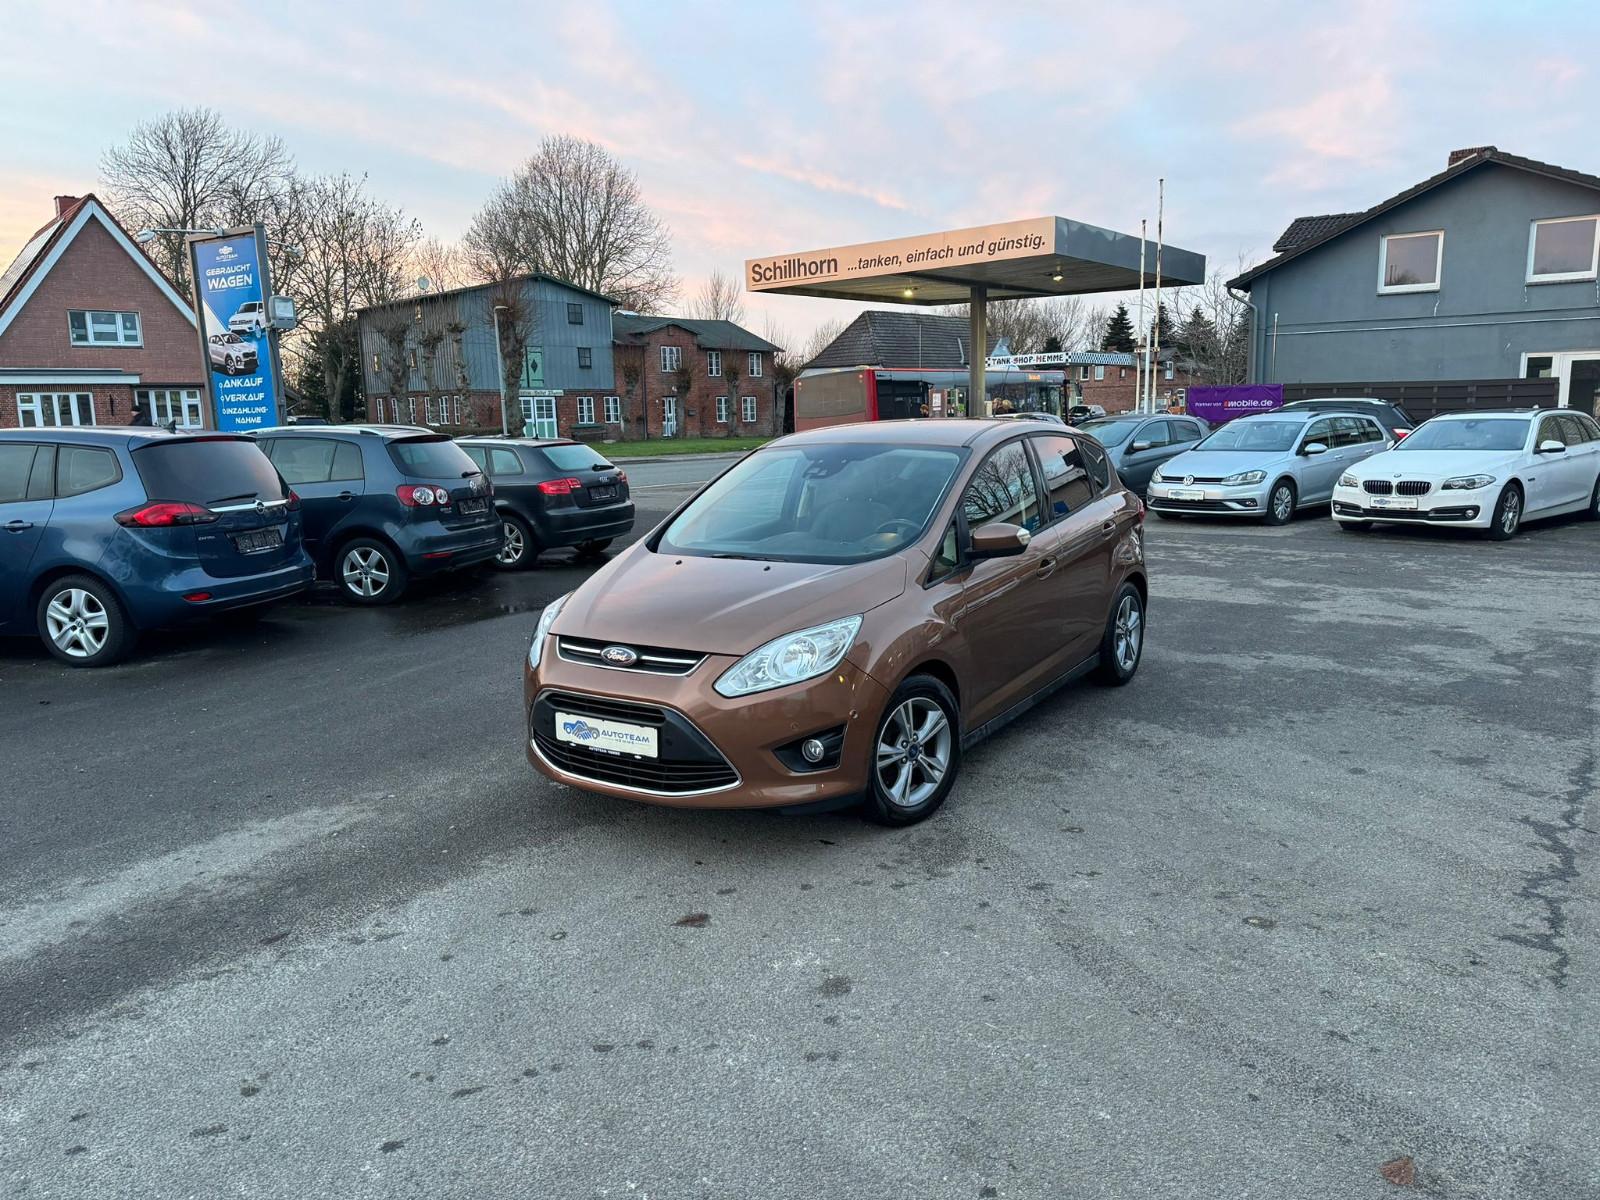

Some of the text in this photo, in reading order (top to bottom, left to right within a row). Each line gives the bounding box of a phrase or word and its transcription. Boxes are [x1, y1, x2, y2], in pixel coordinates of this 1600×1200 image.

[752, 233, 1046, 283] Schillhorn ...tanken, einfach und günstig.
[206, 263, 251, 276] GEBRAUCHT
[207, 273, 253, 290] WAGEN
[223, 377, 264, 388] ANKAUF
[224, 392, 265, 402] VERKAUF
[1228, 399, 1273, 408] mobile.de
[235, 416, 262, 424] NAHME
[607, 649, 627, 662] Ford
[601, 729, 650, 743] AUTOTEAM
